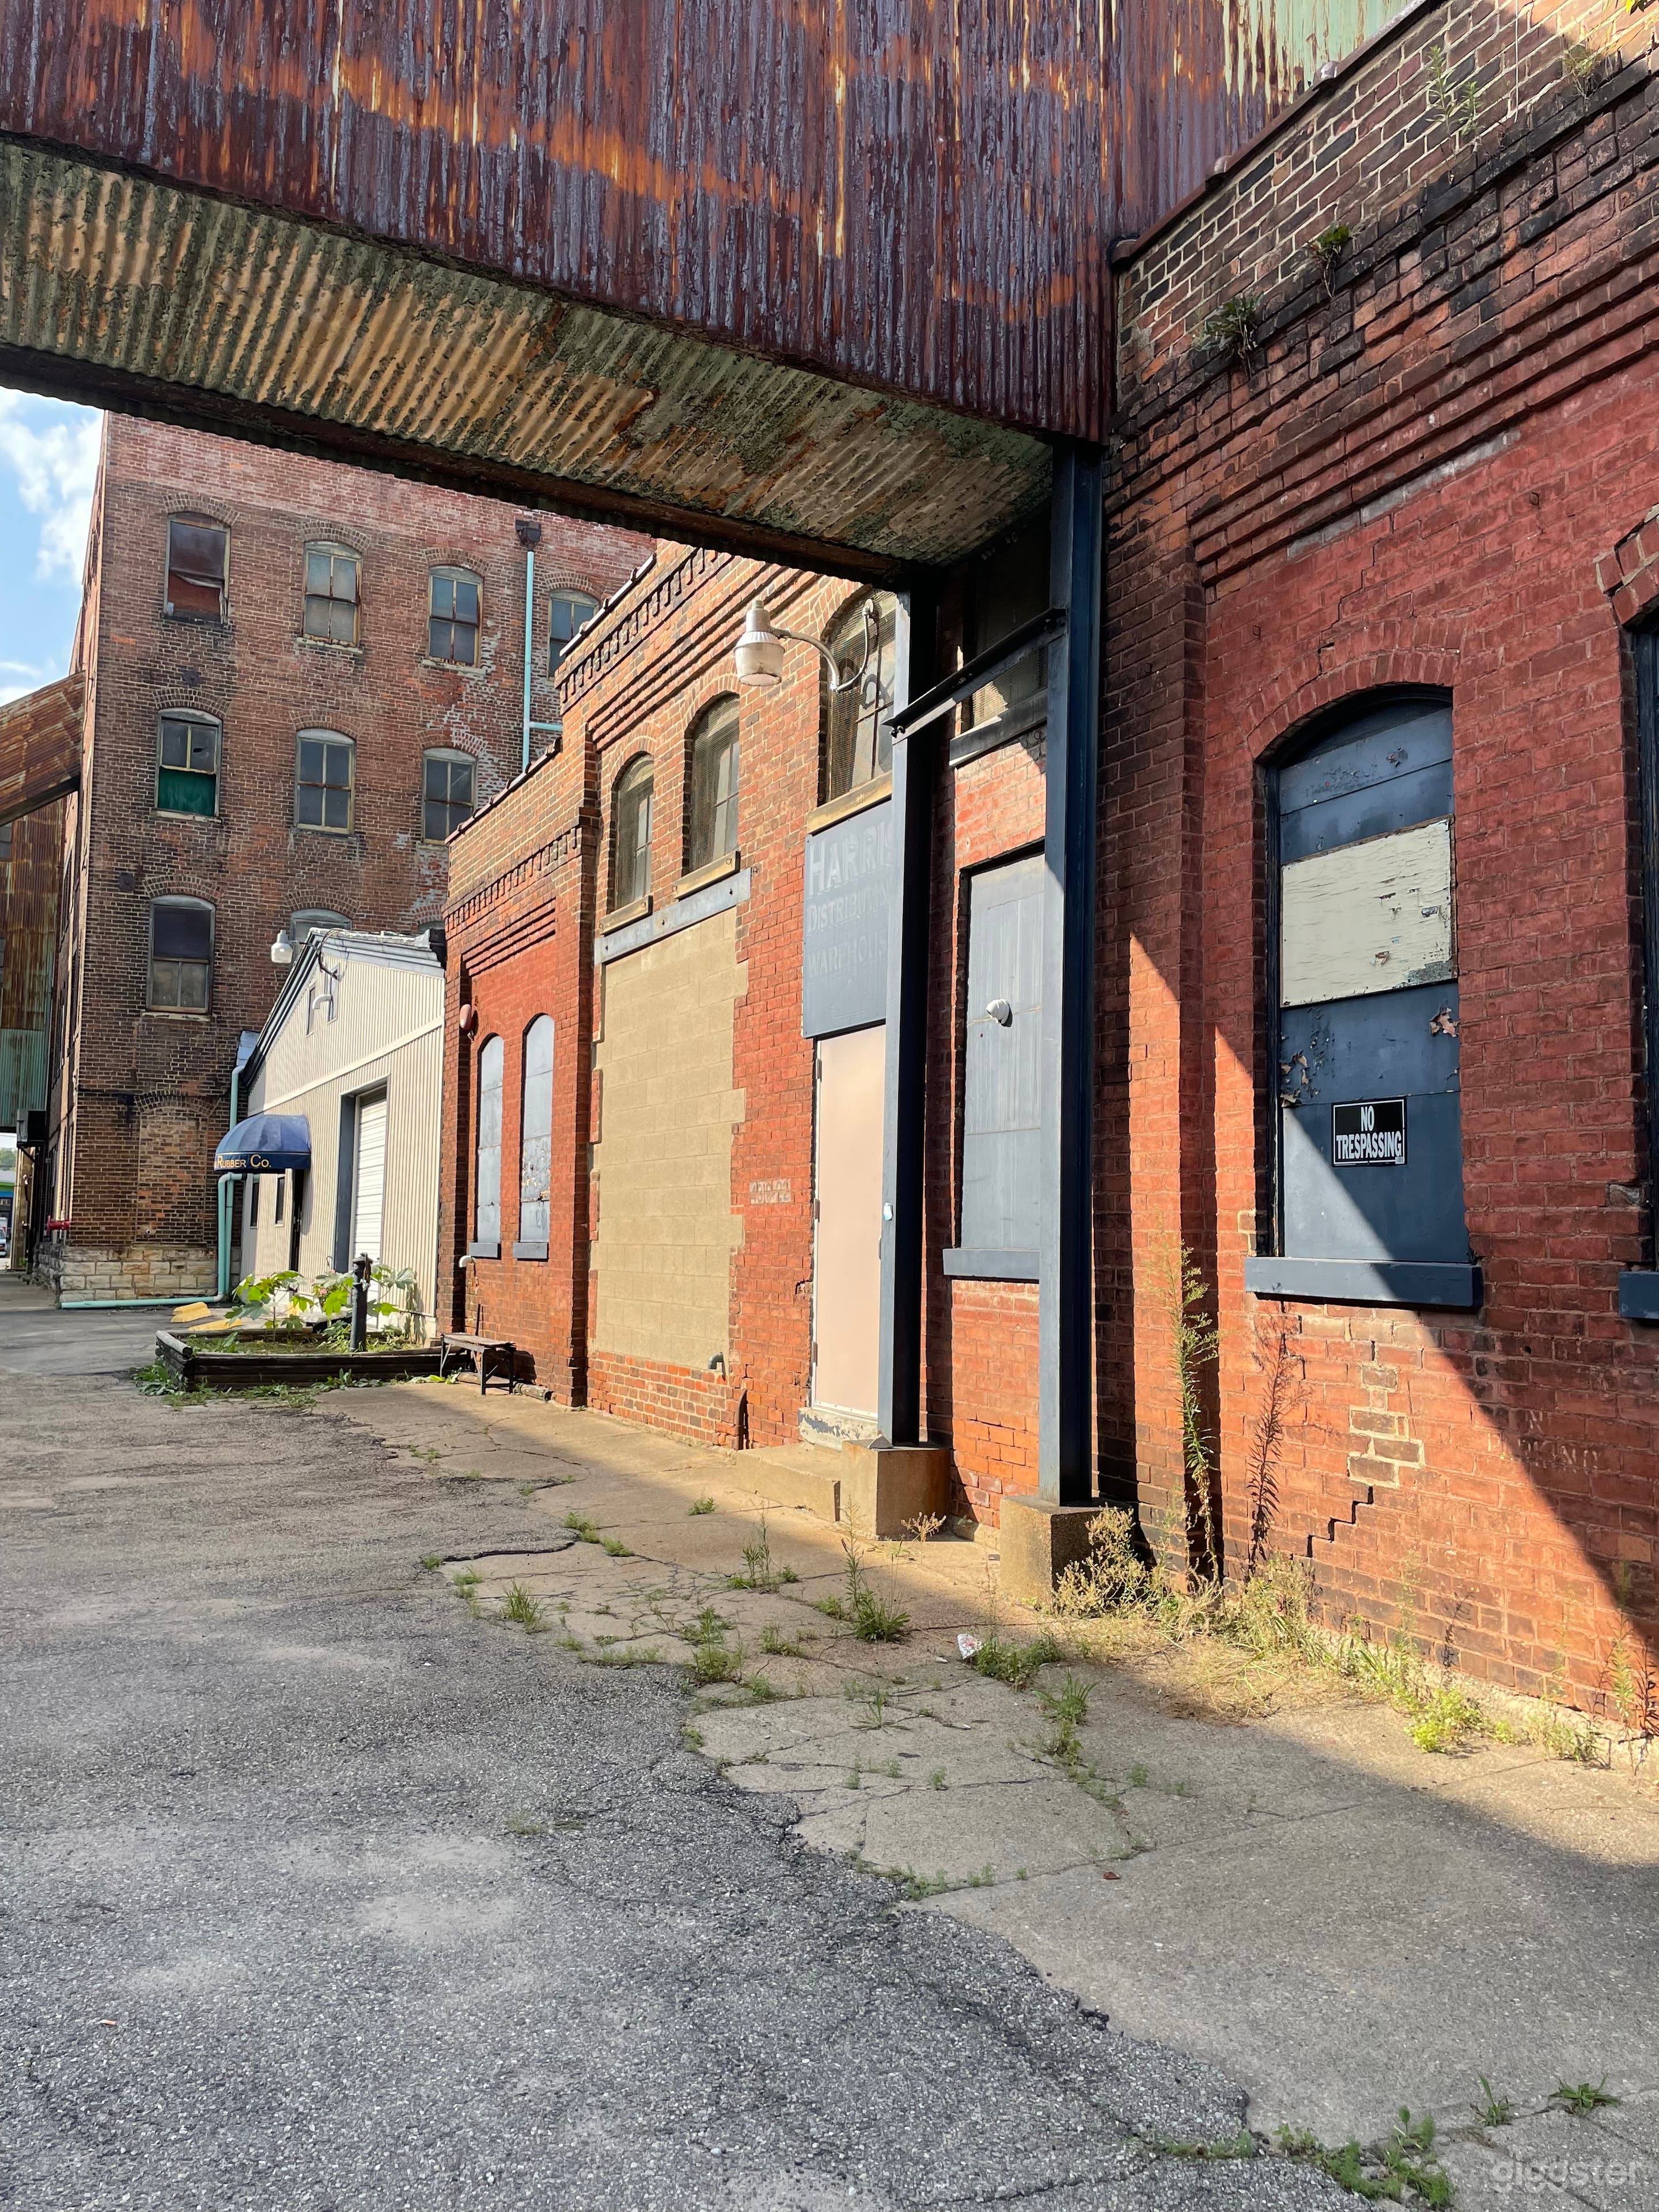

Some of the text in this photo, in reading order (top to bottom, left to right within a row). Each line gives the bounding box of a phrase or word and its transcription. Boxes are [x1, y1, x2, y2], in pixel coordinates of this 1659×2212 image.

[1361, 1105, 1374, 1131] NO
[1336, 1131, 1402, 1159] TRESPASSING
[217, 1154, 247, 1168] RUBBER
